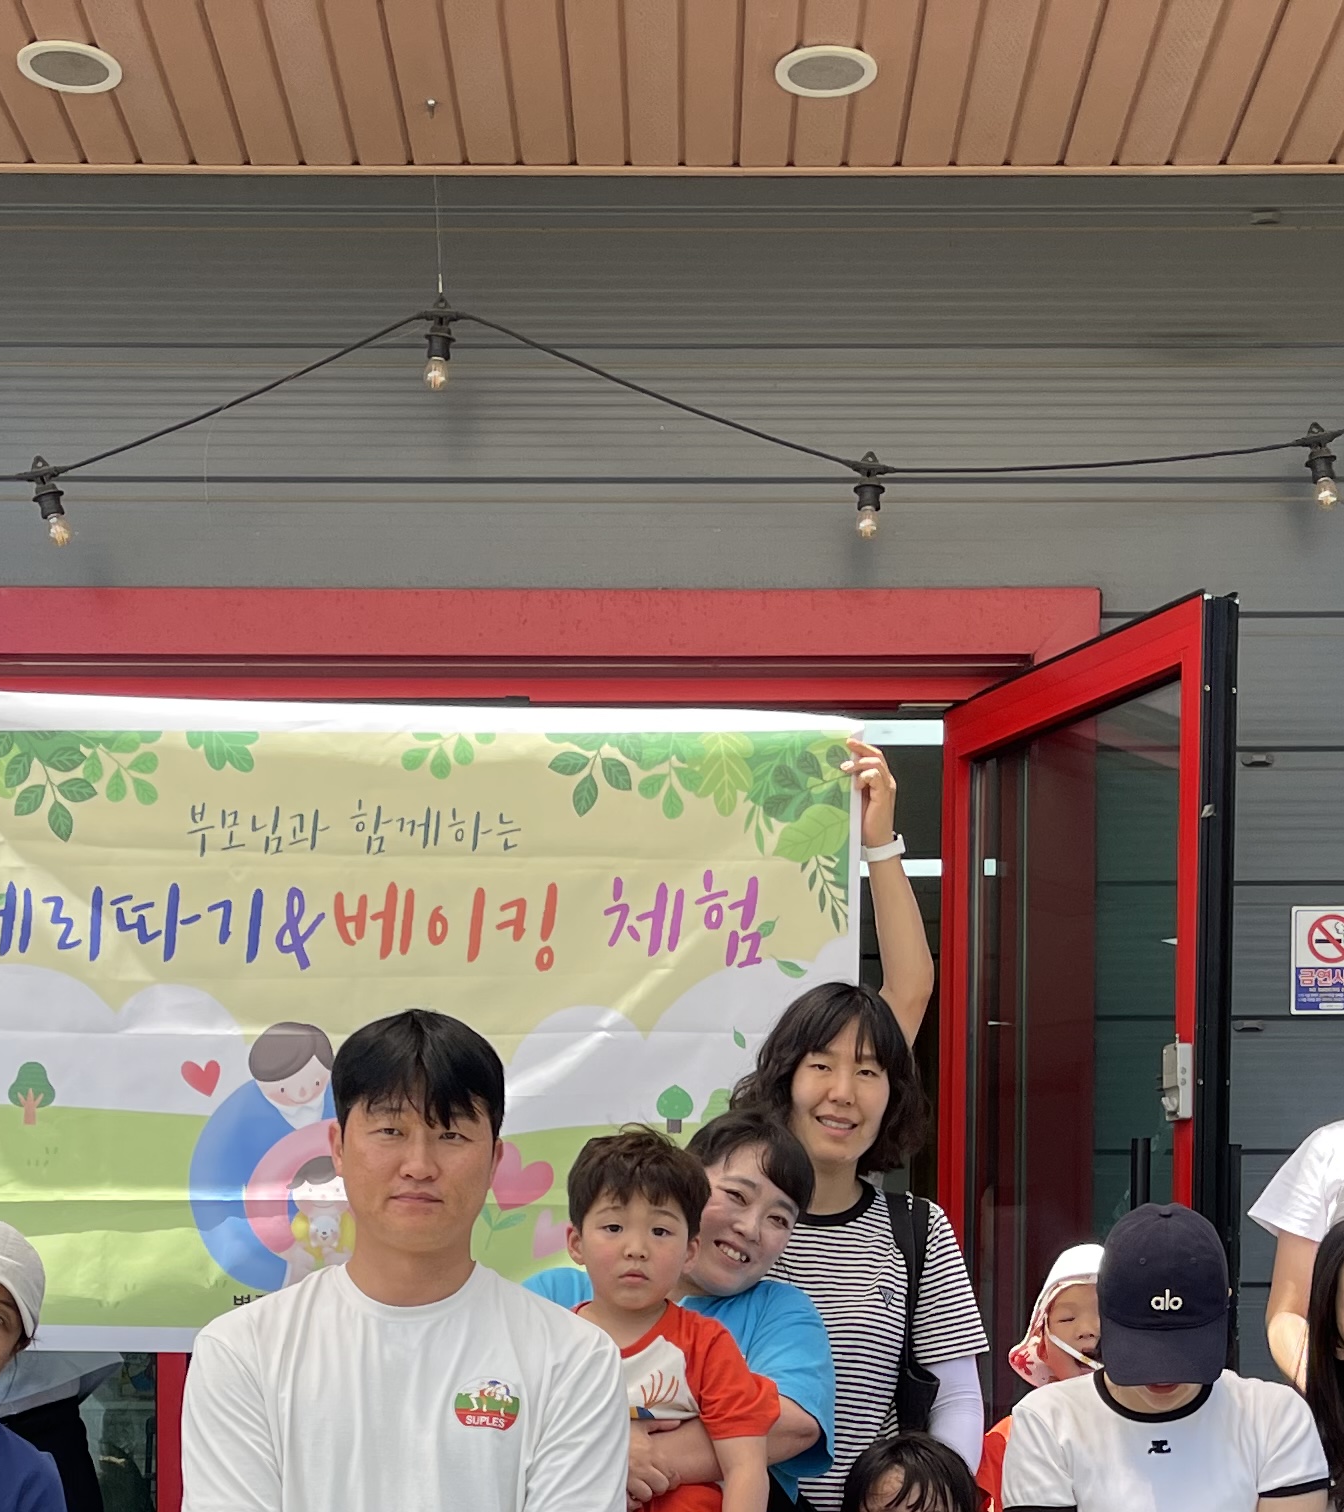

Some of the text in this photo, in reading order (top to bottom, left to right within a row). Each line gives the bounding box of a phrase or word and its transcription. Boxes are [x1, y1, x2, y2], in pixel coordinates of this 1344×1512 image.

[187, 799, 522, 857] 부모님과 함께하는
[604, 869, 762, 968] 체험
[1151, 1288, 1183, 1311] alo
[465, 1415, 505, 1429] SUPLES
